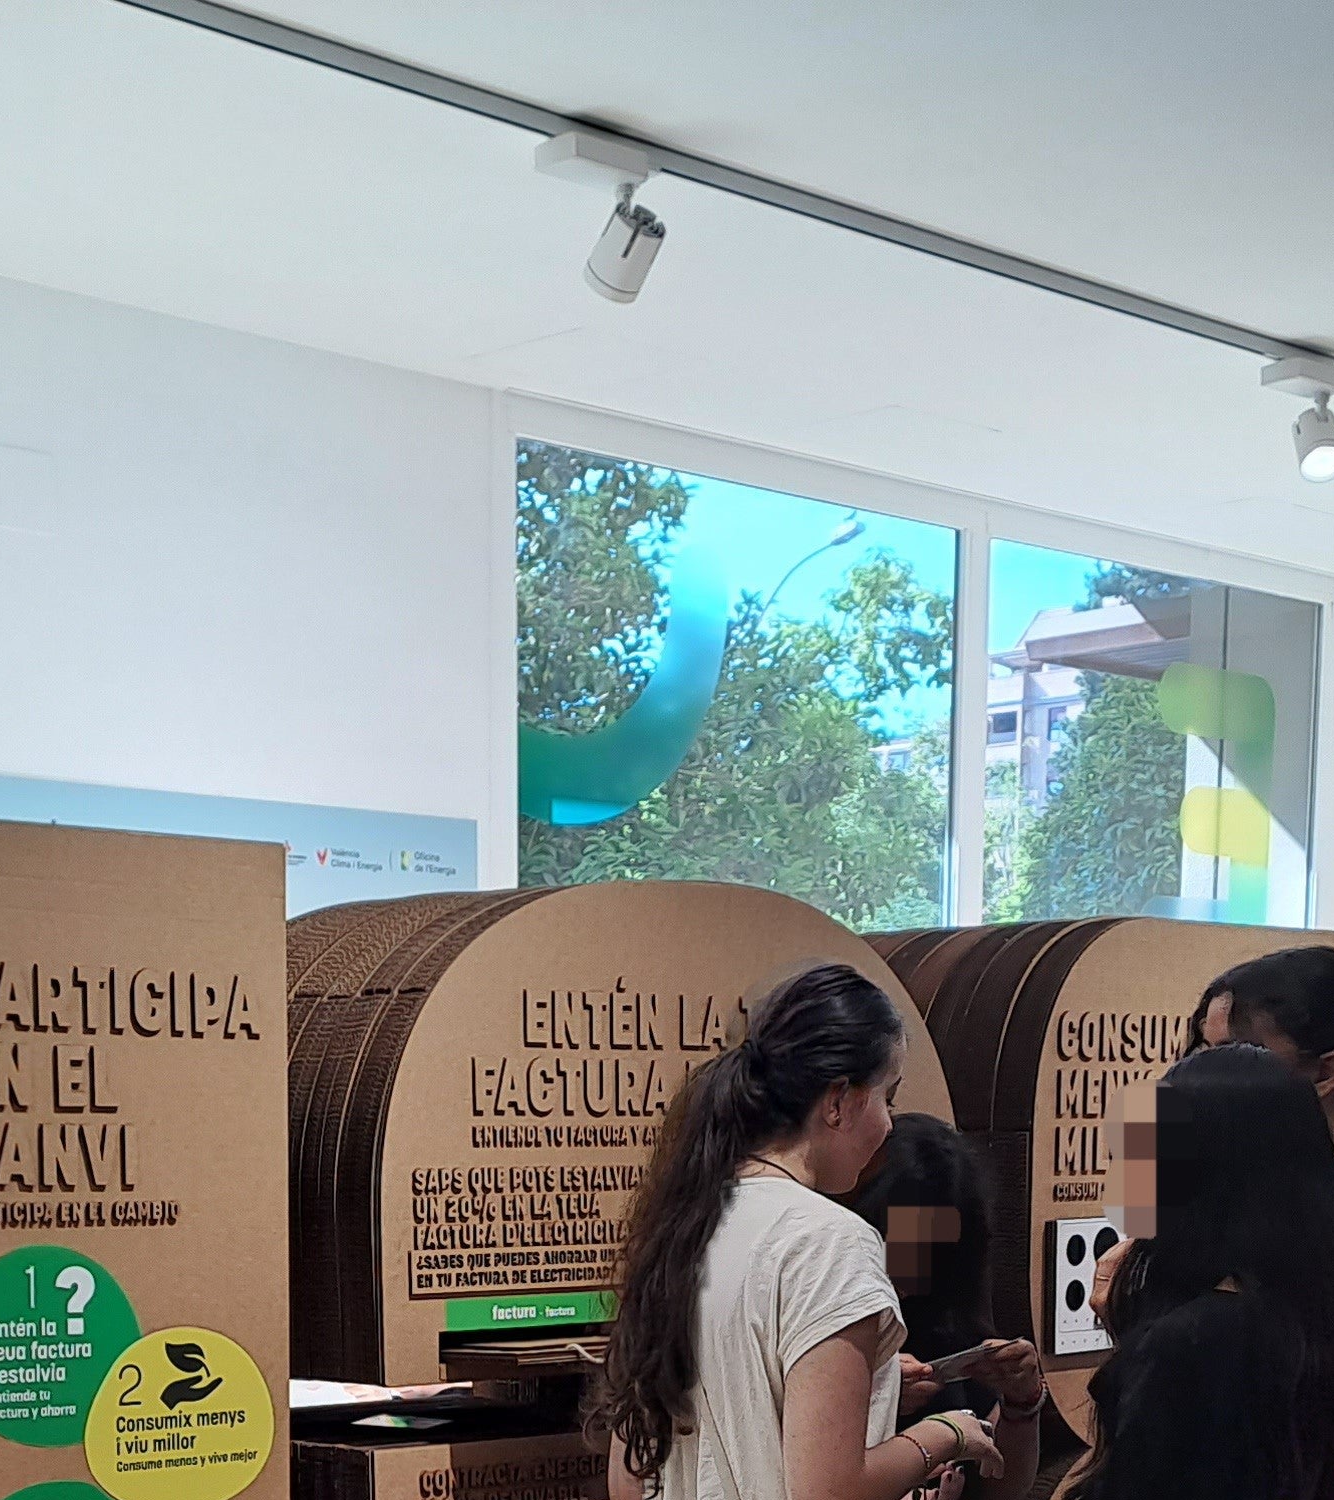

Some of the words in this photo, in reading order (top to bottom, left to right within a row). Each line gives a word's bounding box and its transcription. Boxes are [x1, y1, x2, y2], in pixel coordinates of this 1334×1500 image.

[522, 976, 664, 1051] ENTÉN
[678, 995, 728, 1051] LA
[1057, 1010, 1193, 1063] CONSUM
[52, 1044, 119, 1114] EL
[471, 1056, 669, 1118] FACTURA
[411, 1167, 463, 1195] SAPS
[467, 1167, 504, 1198] QUE
[509, 1166, 555, 1193] POTS
[56, 1202, 81, 1228] EN
[84, 1202, 106, 1227] EL
[111, 1201, 180, 1227] CAMBIO
[413, 1197, 439, 1224] UN
[445, 1195, 498, 1223] 20%
[24, 1265, 36, 1309] 1
[40, 1319, 57, 1337] la
[491, 1304, 536, 1321] factura
[31, 1342, 92, 1360] factura
[117, 1364, 142, 1406] 2
[116, 1414, 192, 1433] Consumix
[196, 1408, 246, 1429] menys
[116, 1437, 121, 1456] i
[125, 1436, 149, 1454] viu
[152, 1433, 196, 1452] millor
[419, 1462, 530, 1498] CONTRACTA
